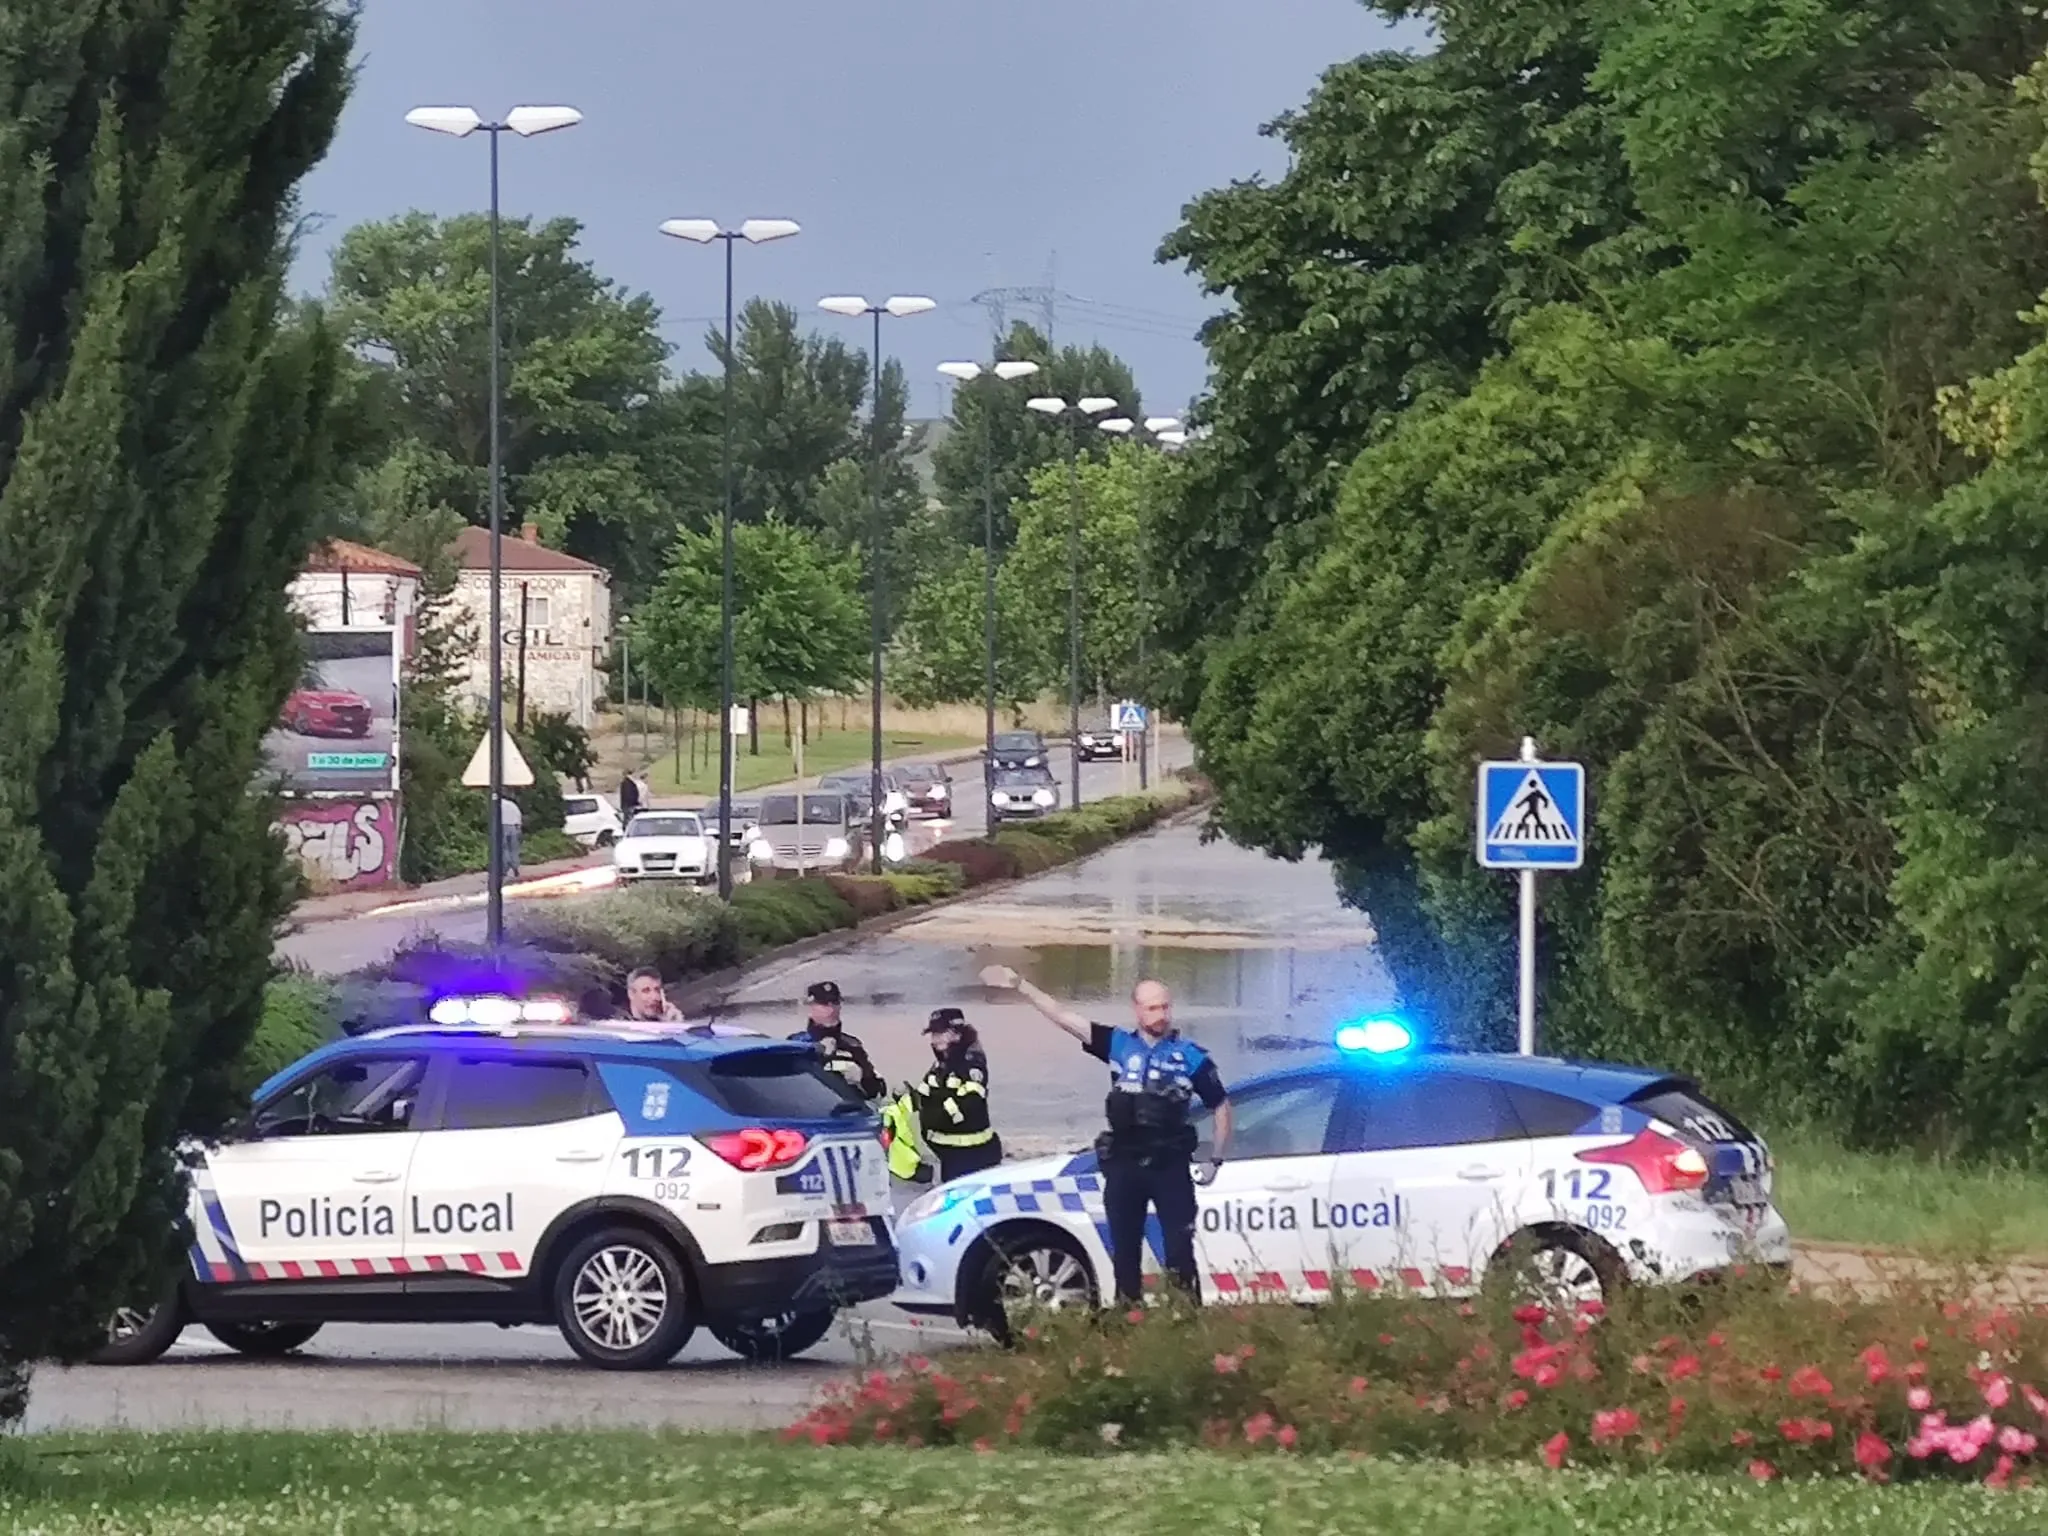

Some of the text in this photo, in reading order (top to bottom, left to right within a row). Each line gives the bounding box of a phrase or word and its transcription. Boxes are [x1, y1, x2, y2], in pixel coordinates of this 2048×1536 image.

[502, 629, 564, 646] GIL
[327, 755, 340, 764] 30
[1685, 1114, 1734, 1142] 112
[622, 1147, 692, 1178] 112
[655, 1182, 690, 1200] 092
[800, 1174, 824, 1190] 112
[1538, 1168, 1612, 1200] 112
[260, 1192, 514, 1239] Policía Local
[1201, 1194, 1400, 1233] olicía Local
[1586, 1204, 1627, 1230] 092
